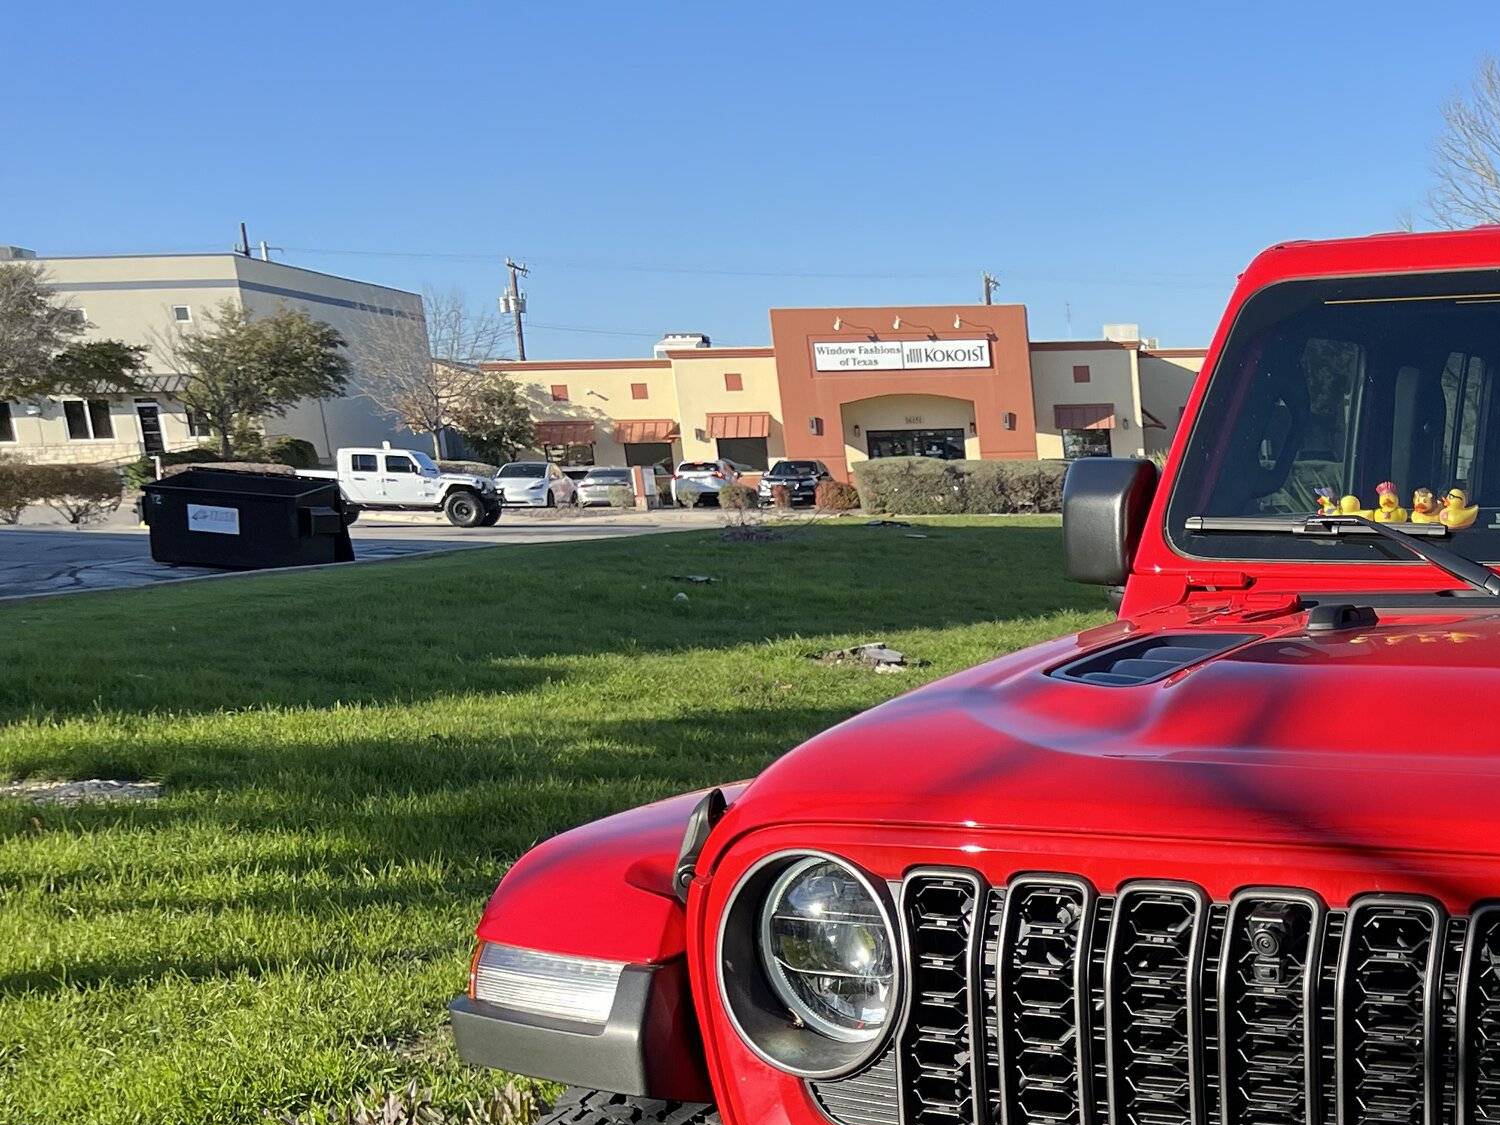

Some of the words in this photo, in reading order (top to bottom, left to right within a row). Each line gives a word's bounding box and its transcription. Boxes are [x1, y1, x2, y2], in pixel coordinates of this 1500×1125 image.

[816, 346, 856, 355] Window
[858, 345, 901, 355] Fashions
[924, 345, 985, 363] KOKOIST
[839, 358, 850, 366] of
[851, 357, 879, 366] Texas
